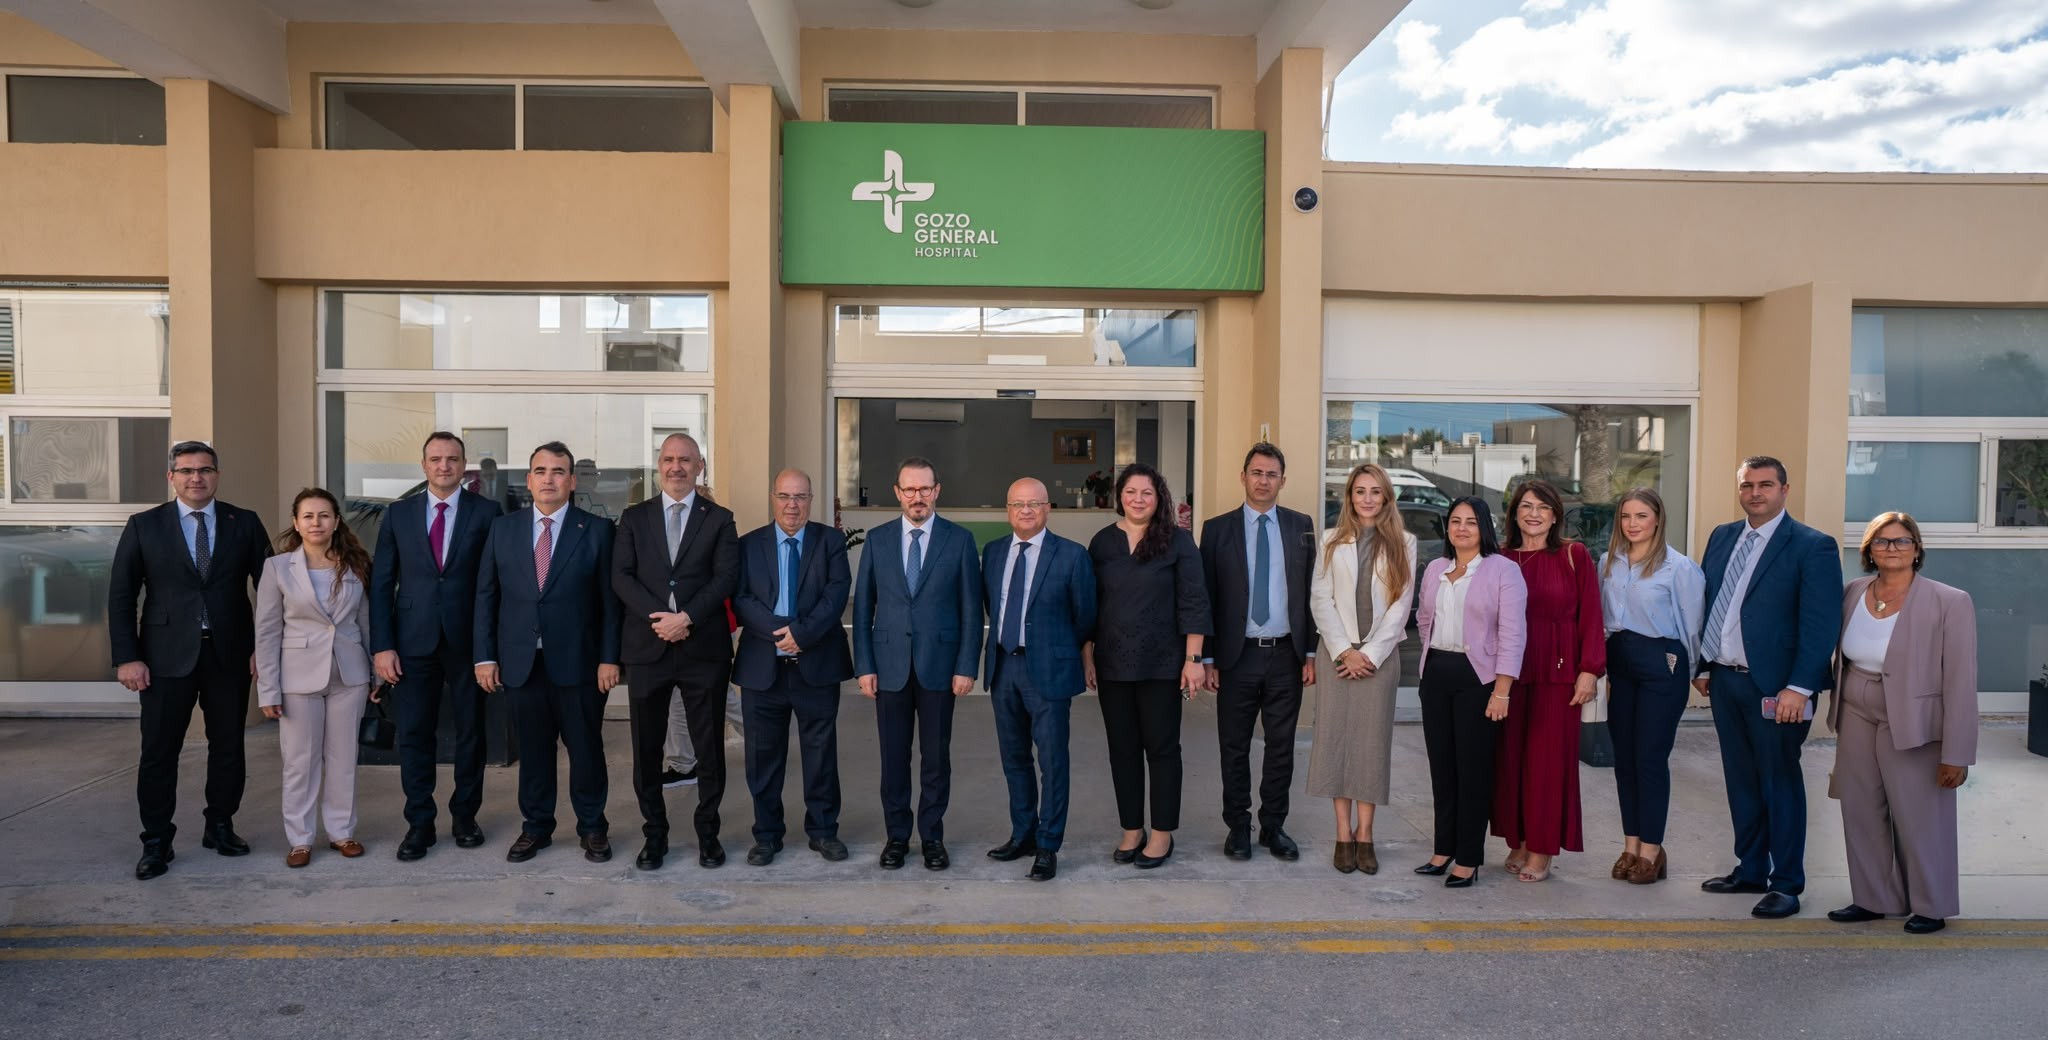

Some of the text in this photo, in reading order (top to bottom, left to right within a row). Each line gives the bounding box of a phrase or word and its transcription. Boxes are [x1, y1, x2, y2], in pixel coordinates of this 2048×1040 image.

[915, 213, 970, 228] GOZO
[915, 229, 999, 244] GENERAL
[915, 247, 978, 258] HOSPITAL
